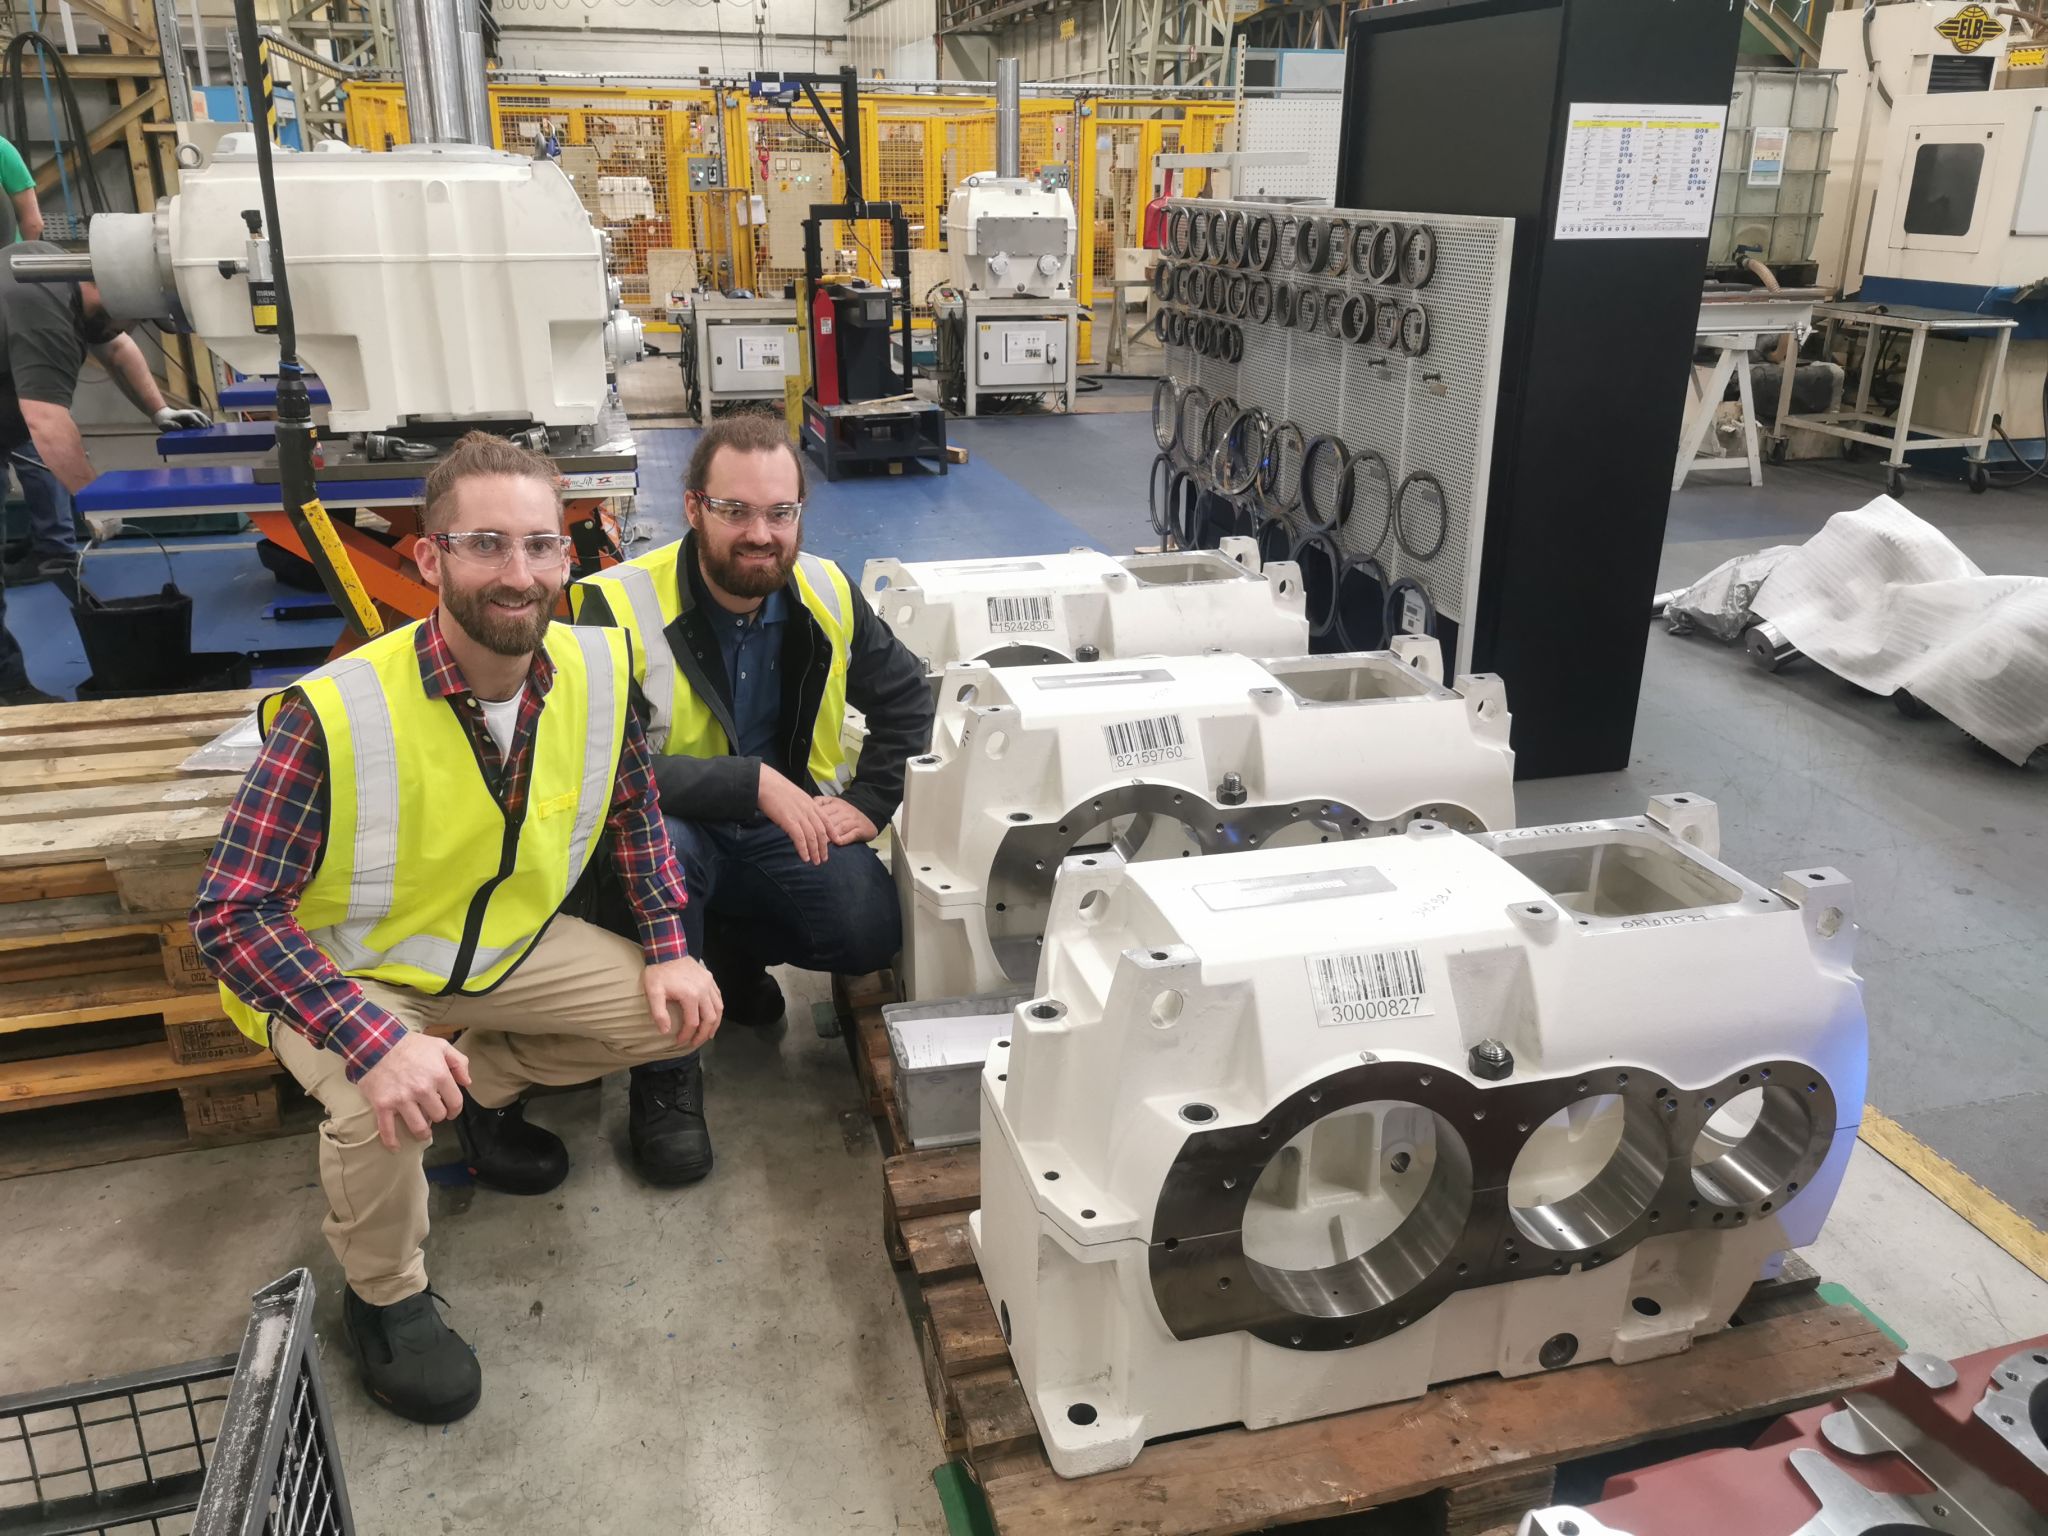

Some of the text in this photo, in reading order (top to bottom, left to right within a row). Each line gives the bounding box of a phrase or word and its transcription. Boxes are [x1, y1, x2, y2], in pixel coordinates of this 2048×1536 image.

[1958, 18, 1984, 39] ELB
[999, 621, 1049, 633] 15242836
[1115, 745, 1183, 768] 82159760
[1331, 996, 1420, 1023] 30000827
